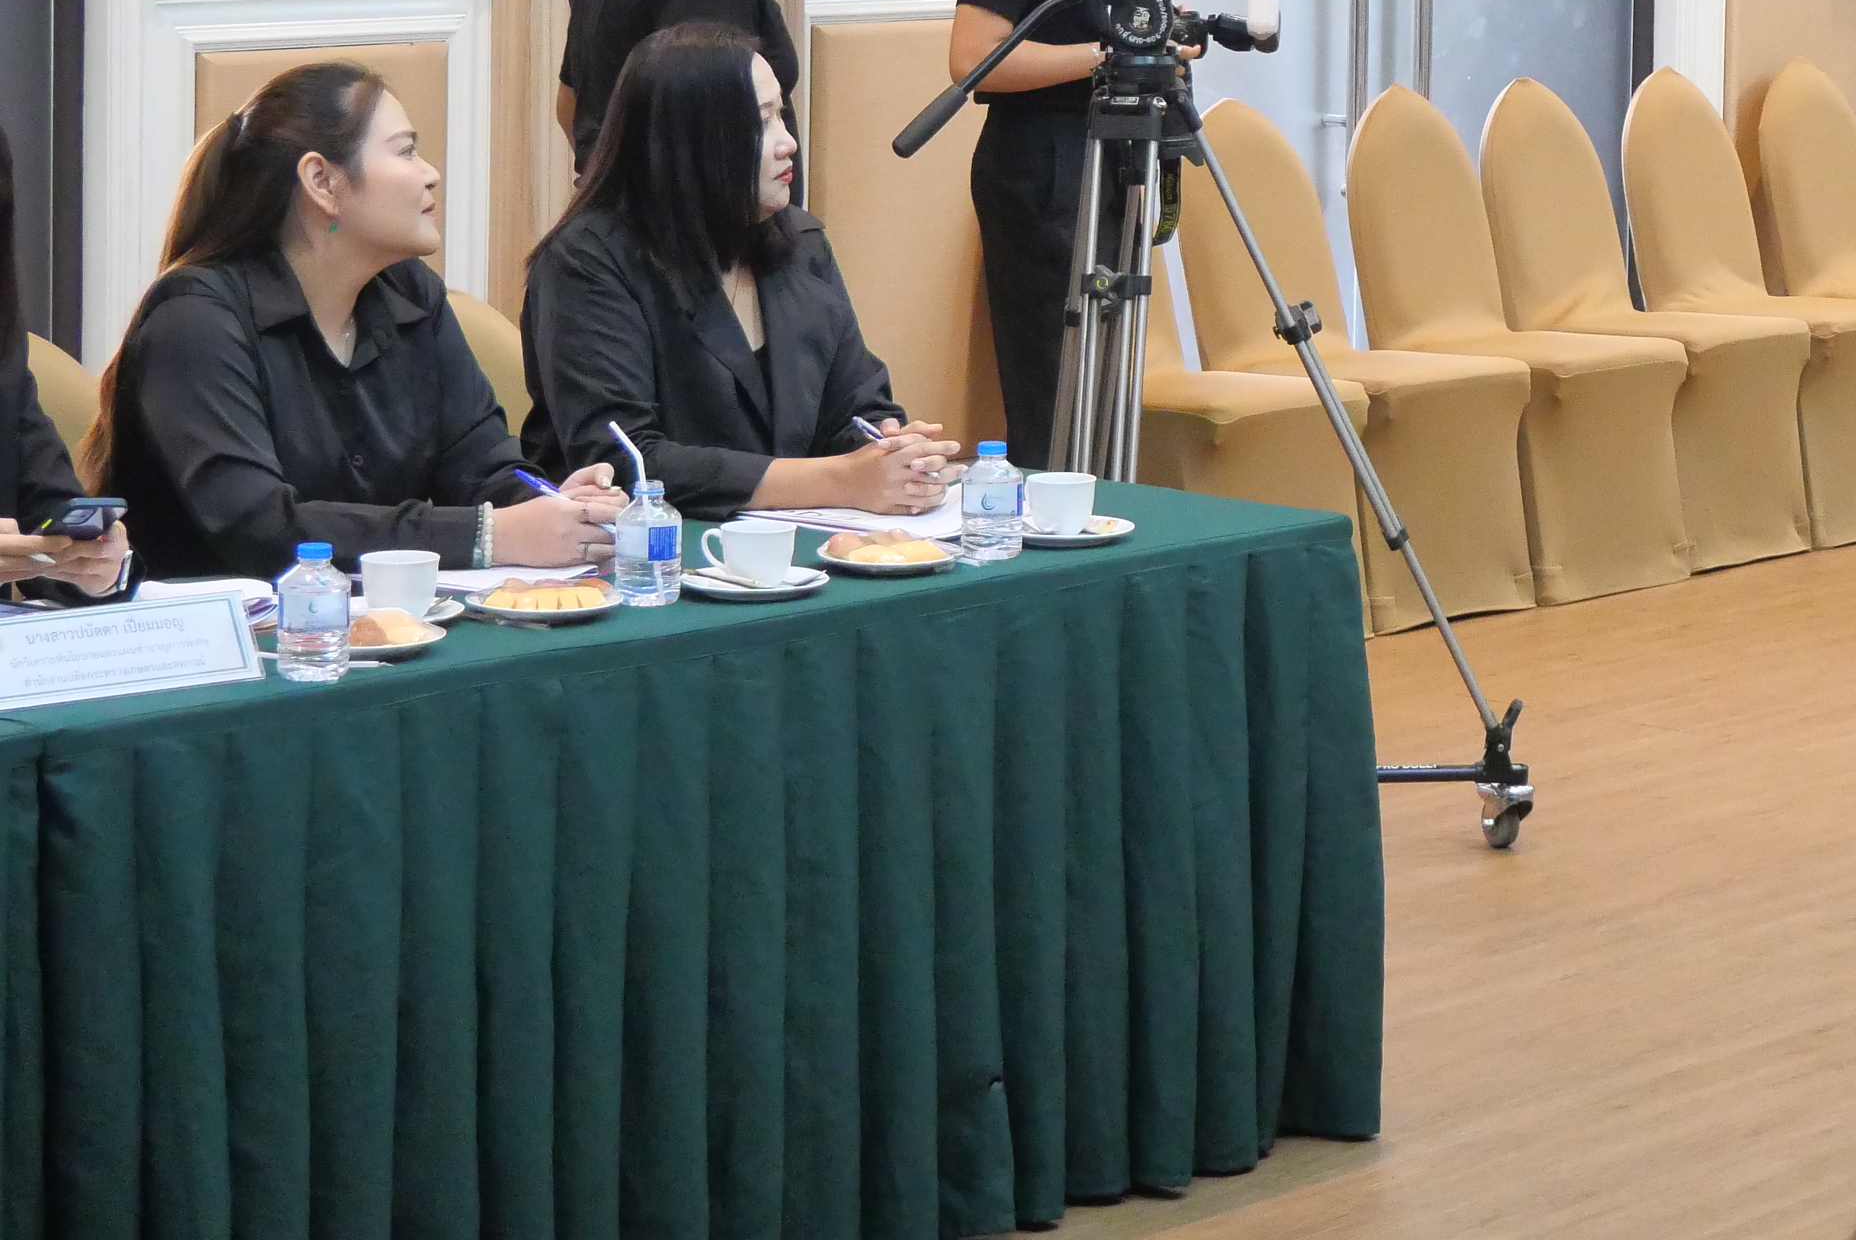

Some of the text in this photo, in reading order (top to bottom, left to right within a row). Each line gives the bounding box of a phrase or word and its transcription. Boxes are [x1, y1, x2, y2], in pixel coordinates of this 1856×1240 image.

[25, 622, 119, 646] นางสาวปนัดดา
